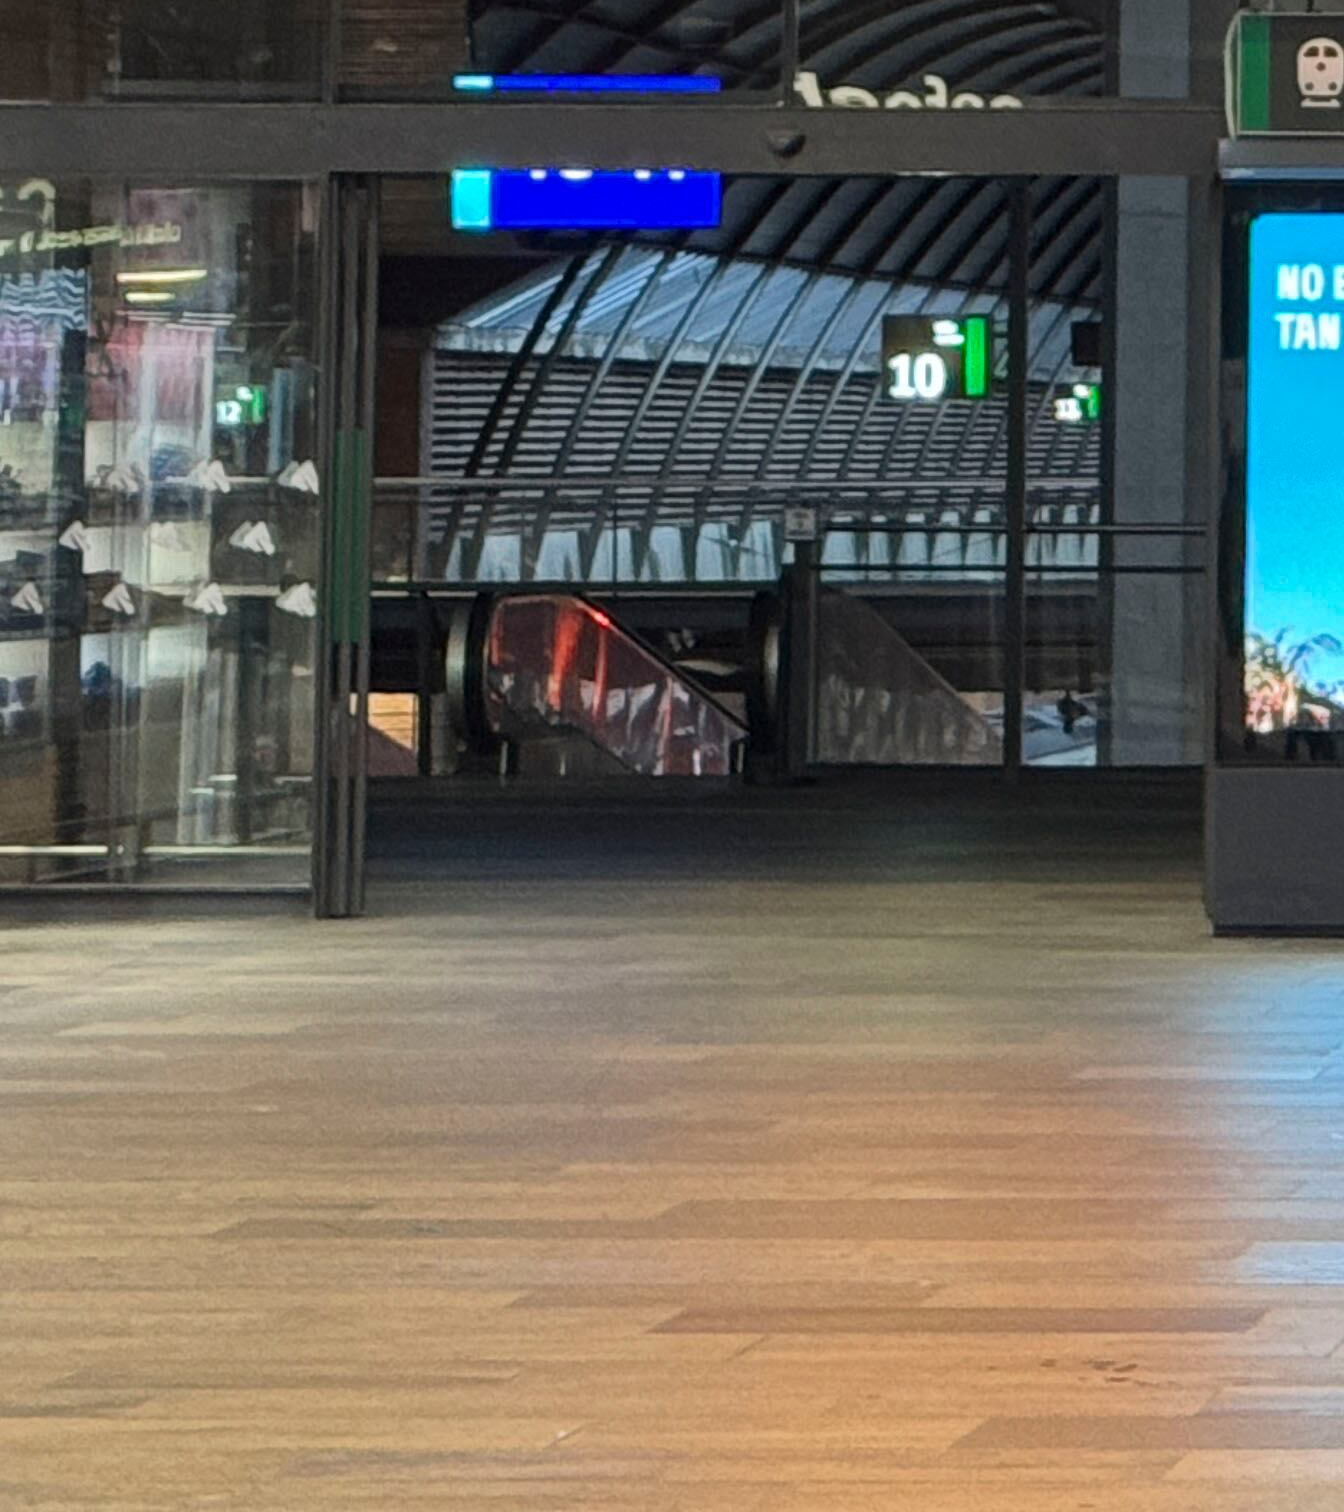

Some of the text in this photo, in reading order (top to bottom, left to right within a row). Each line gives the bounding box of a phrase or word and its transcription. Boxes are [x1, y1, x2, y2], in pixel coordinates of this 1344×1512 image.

[1277, 263, 1325, 301] NO
[1275, 312, 1341, 350] TAN
[888, 352, 947, 399] 10
